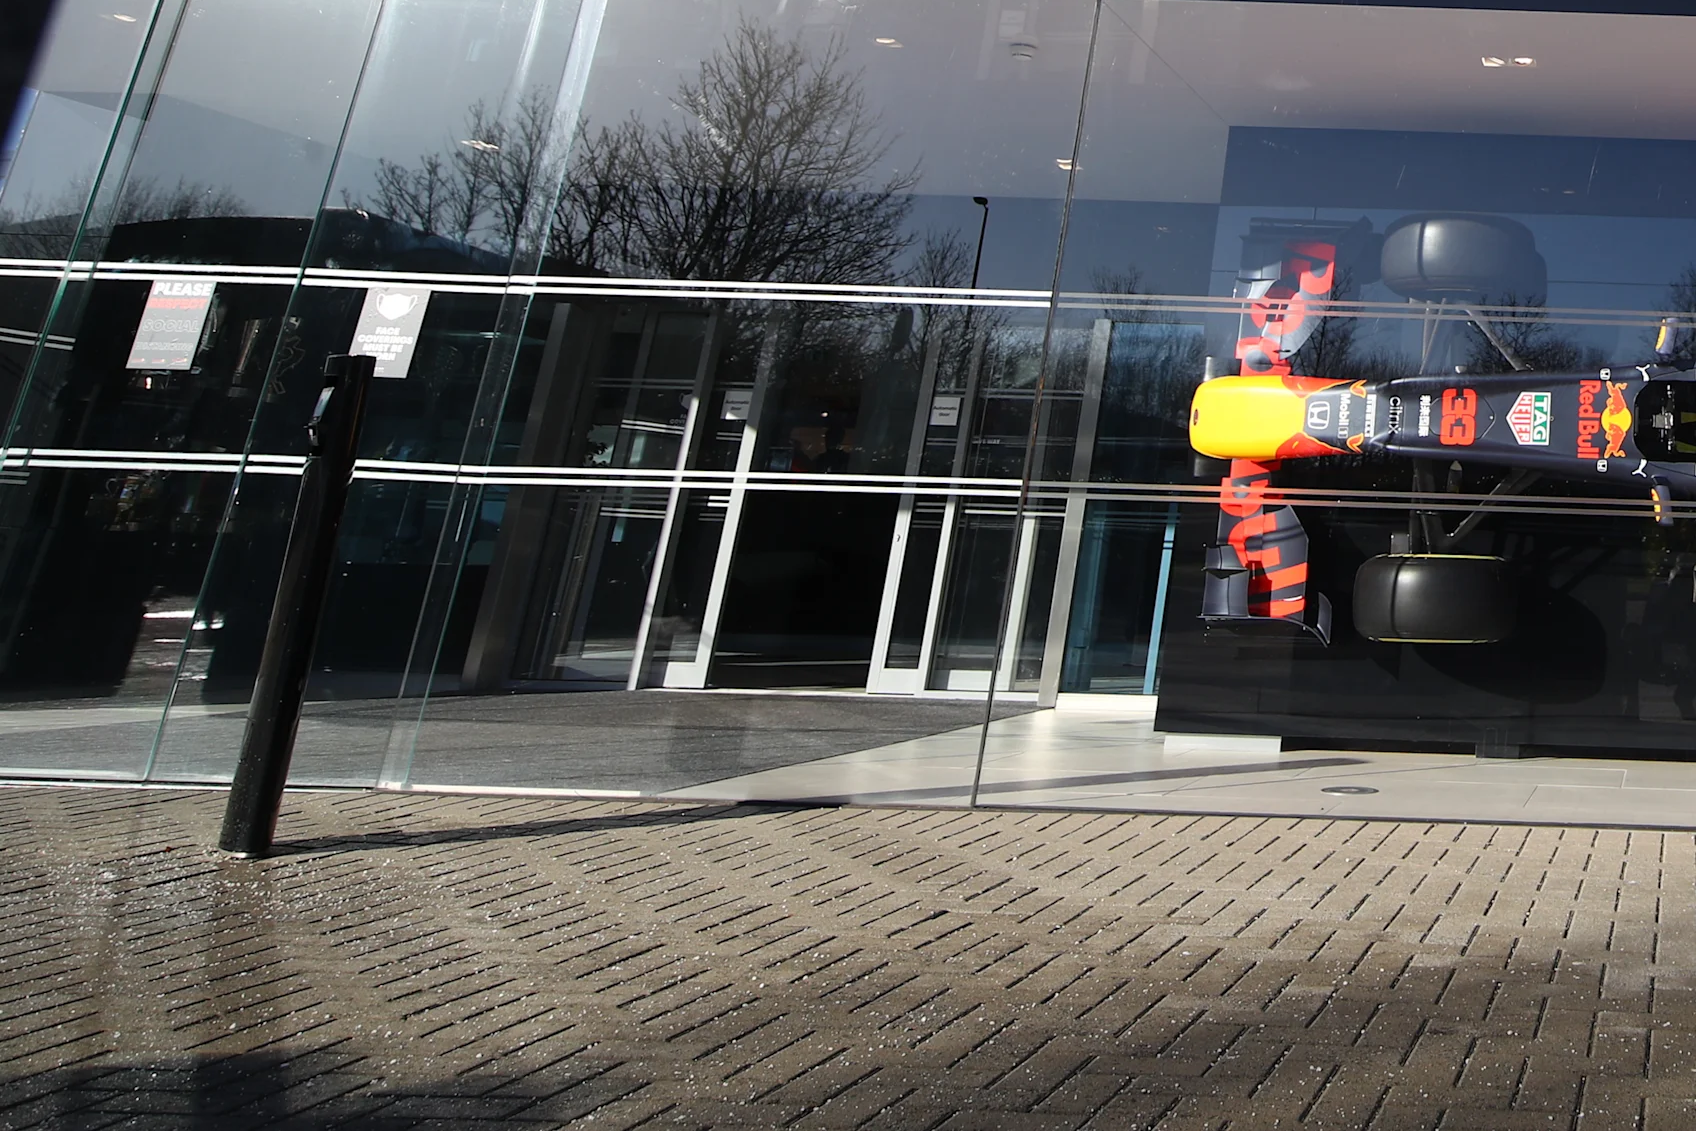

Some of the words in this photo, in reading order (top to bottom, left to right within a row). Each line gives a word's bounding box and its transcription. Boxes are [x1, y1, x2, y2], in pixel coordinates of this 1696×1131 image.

[153, 282, 213, 296] PLEASE
[143, 319, 199, 332] SOCIAL
[357, 334, 414, 345] COVERINGS
[375, 326, 400, 335] FACE
[362, 343, 390, 352] MUST
[390, 344, 404, 352] BE
[1338, 393, 1351, 426] Mobil
[1578, 379, 1602, 418] Red
[1440, 388, 1477, 446] 33
[1509, 395, 1533, 442] HEUER
[1533, 395, 1549, 442] TAG
[1576, 420, 1600, 459] Bull
